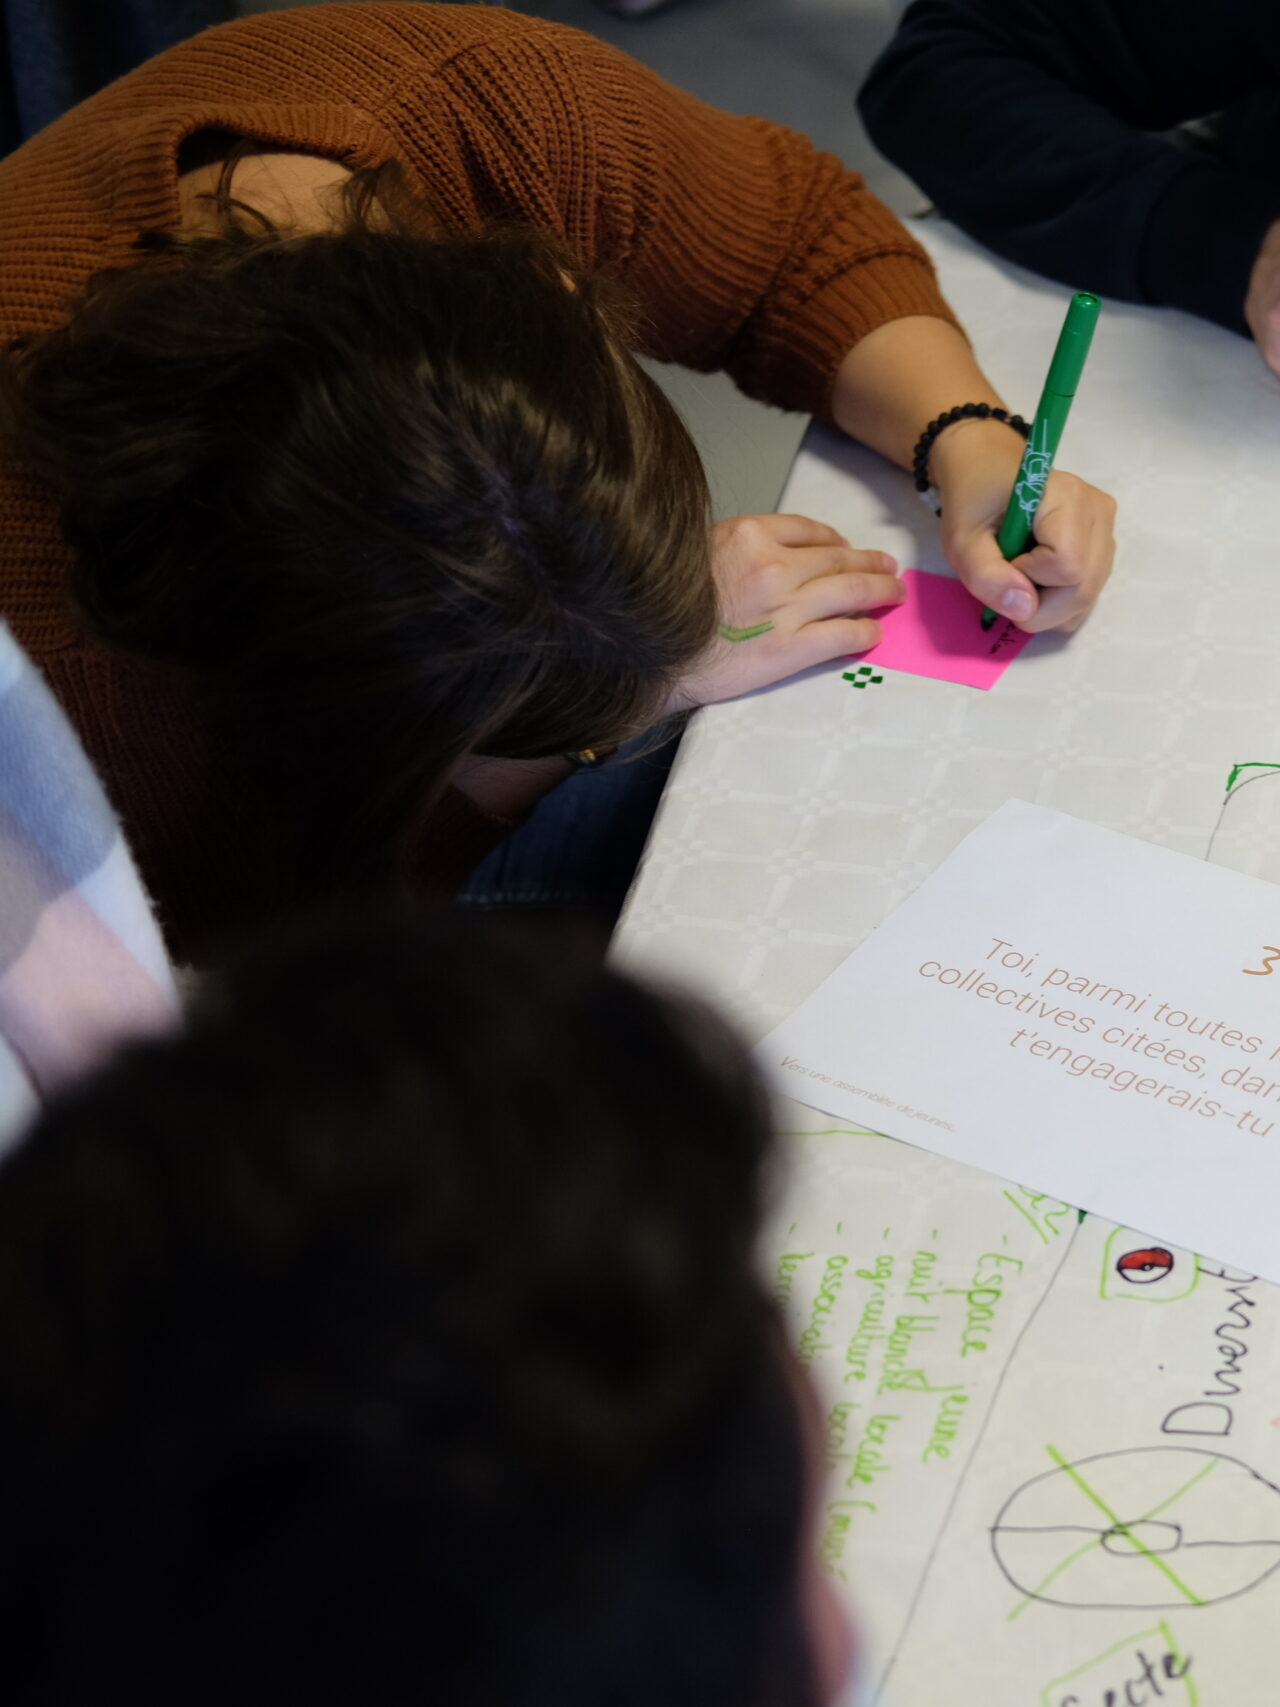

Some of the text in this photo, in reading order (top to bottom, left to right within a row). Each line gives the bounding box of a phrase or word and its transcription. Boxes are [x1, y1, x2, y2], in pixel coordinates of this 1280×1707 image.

[918, 960, 1096, 1034] collectives
[1101, 1026, 1207, 1080] citées,
[983, 937, 1040, 979] Toi,
[1040, 966, 1153, 1014] parmi
[1152, 1001, 1264, 1054] toutes
[780, 1055, 809, 1074] Vers
[1008, 1028, 1275, 1137] t'engagerais-tu
[943, 1252, 1024, 1359] Espace
[1160, 1264, 1260, 1437] Diversit
